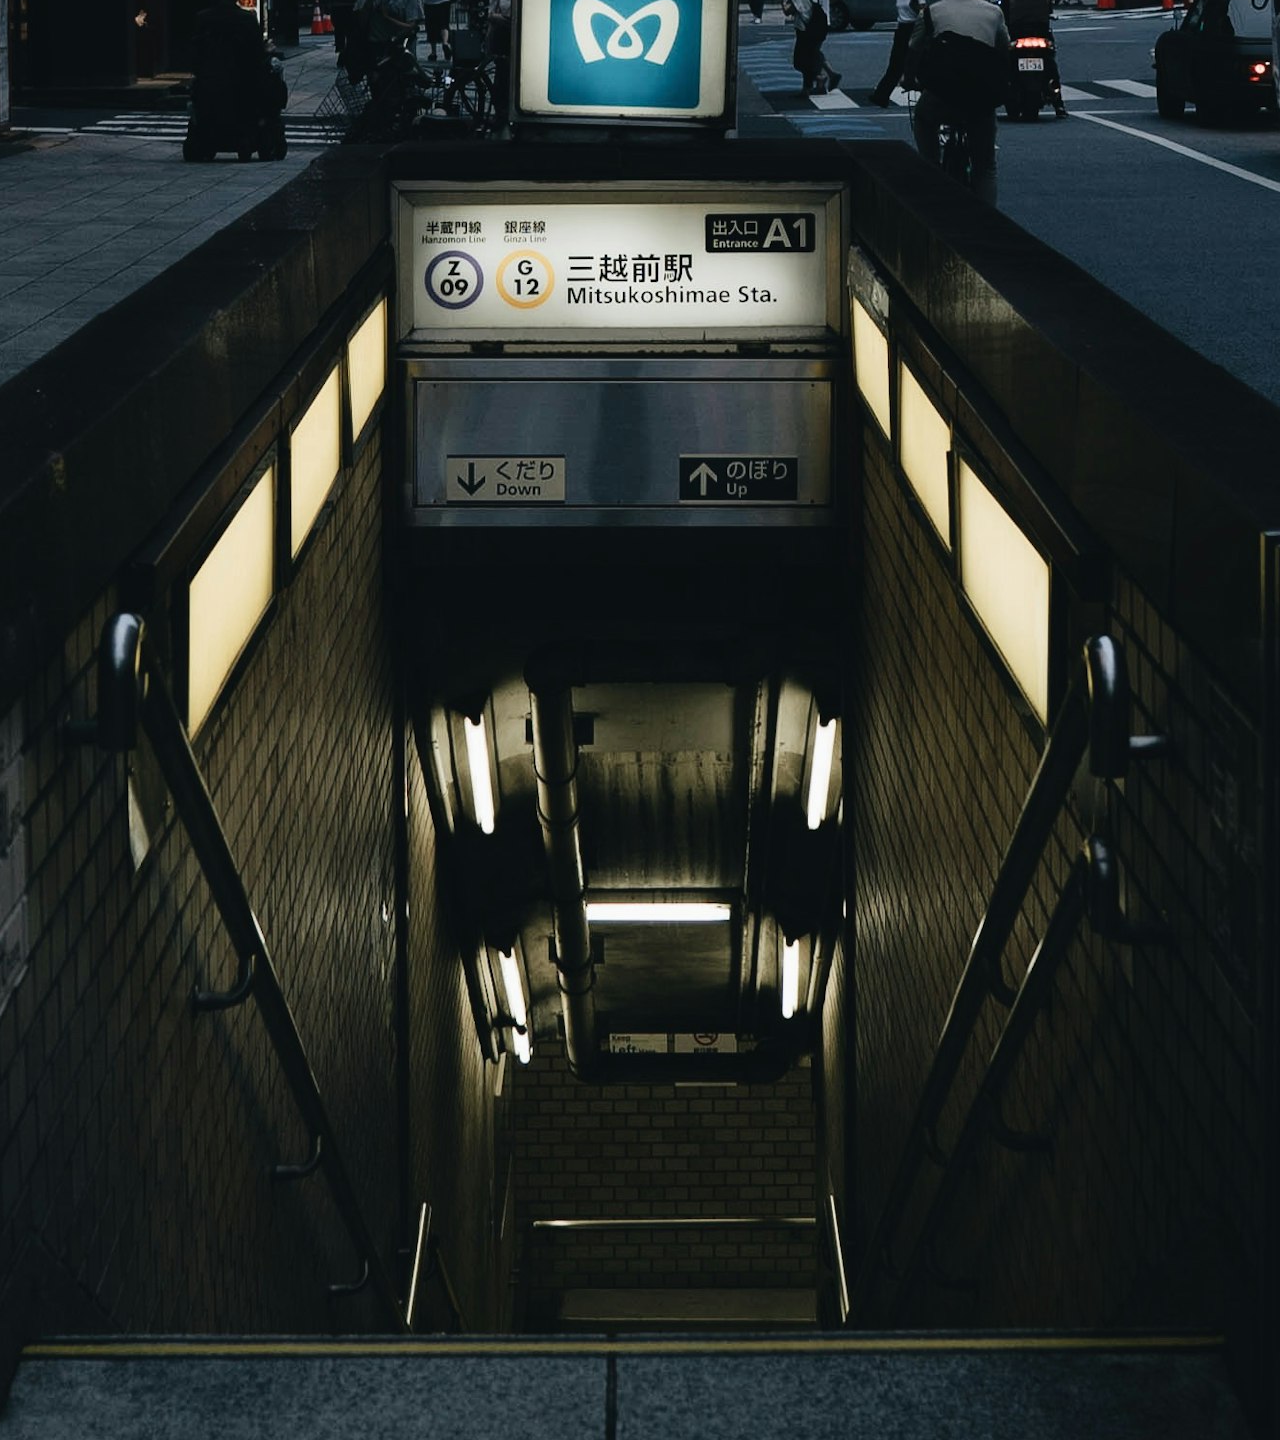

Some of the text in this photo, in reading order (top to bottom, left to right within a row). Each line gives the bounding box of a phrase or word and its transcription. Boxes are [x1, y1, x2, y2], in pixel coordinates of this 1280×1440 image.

[426, 220, 547, 235] 半蔵門線 銀座線
[712, 219, 758, 236] 出入口
[762, 218, 807, 249] A1
[421, 235, 487, 244] Hanzomon Line
[503, 235, 547, 244] Ginza Line
[712, 238, 759, 249] Entrance
[447, 260, 461, 276] Z
[517, 259, 533, 276] G
[566, 254, 693, 283] 三越前駅
[439, 279, 468, 296] 09
[514, 279, 539, 295] 12
[567, 285, 778, 304] Mitsukoshimae Sta.
[496, 460, 555, 480] くだり
[726, 460, 789, 480] のぼり
[497, 483, 541, 496] Down
[727, 482, 748, 497] Up
